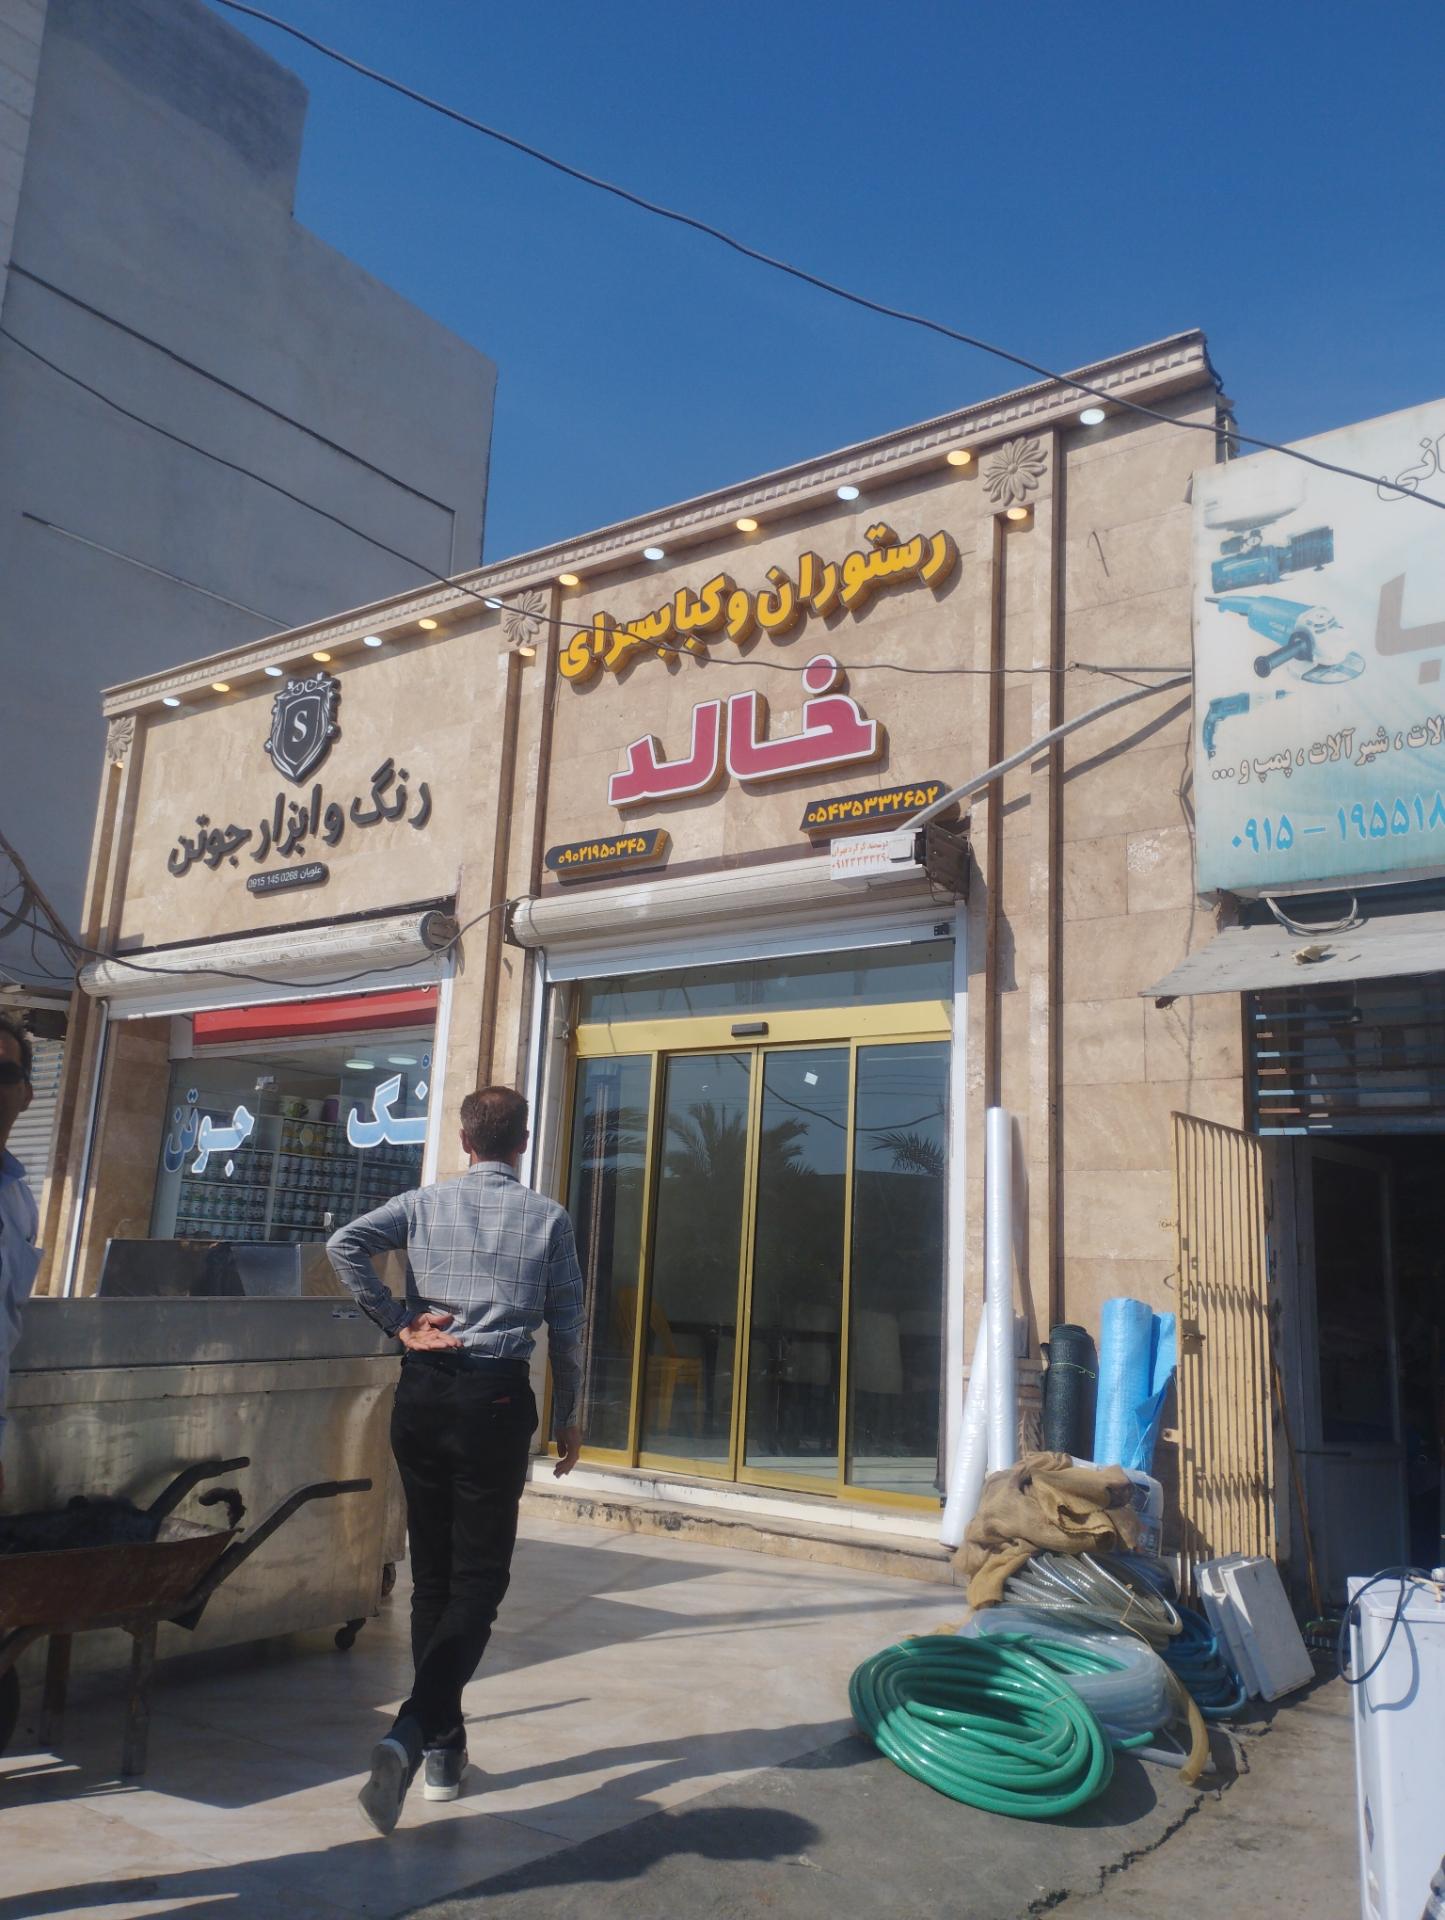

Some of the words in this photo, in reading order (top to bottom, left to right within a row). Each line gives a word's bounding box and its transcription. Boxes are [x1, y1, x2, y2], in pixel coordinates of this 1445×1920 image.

[757, 521, 953, 631] رستوران
[725, 588, 752, 641] و
[291, 709, 309, 743] S
[607, 653, 880, 808] خالد
[350, 757, 432, 829] رنگ
[1253, 748, 1293, 783] پمپ
[167, 814, 253, 878] جوتن
[251, 783, 323, 863] ابزار
[322, 802, 345, 847] و
[1231, 814, 1294, 853] ۰۹۱۵
[164, 1087, 255, 1177] جوتن
[346, 1073, 431, 1148] نگ
